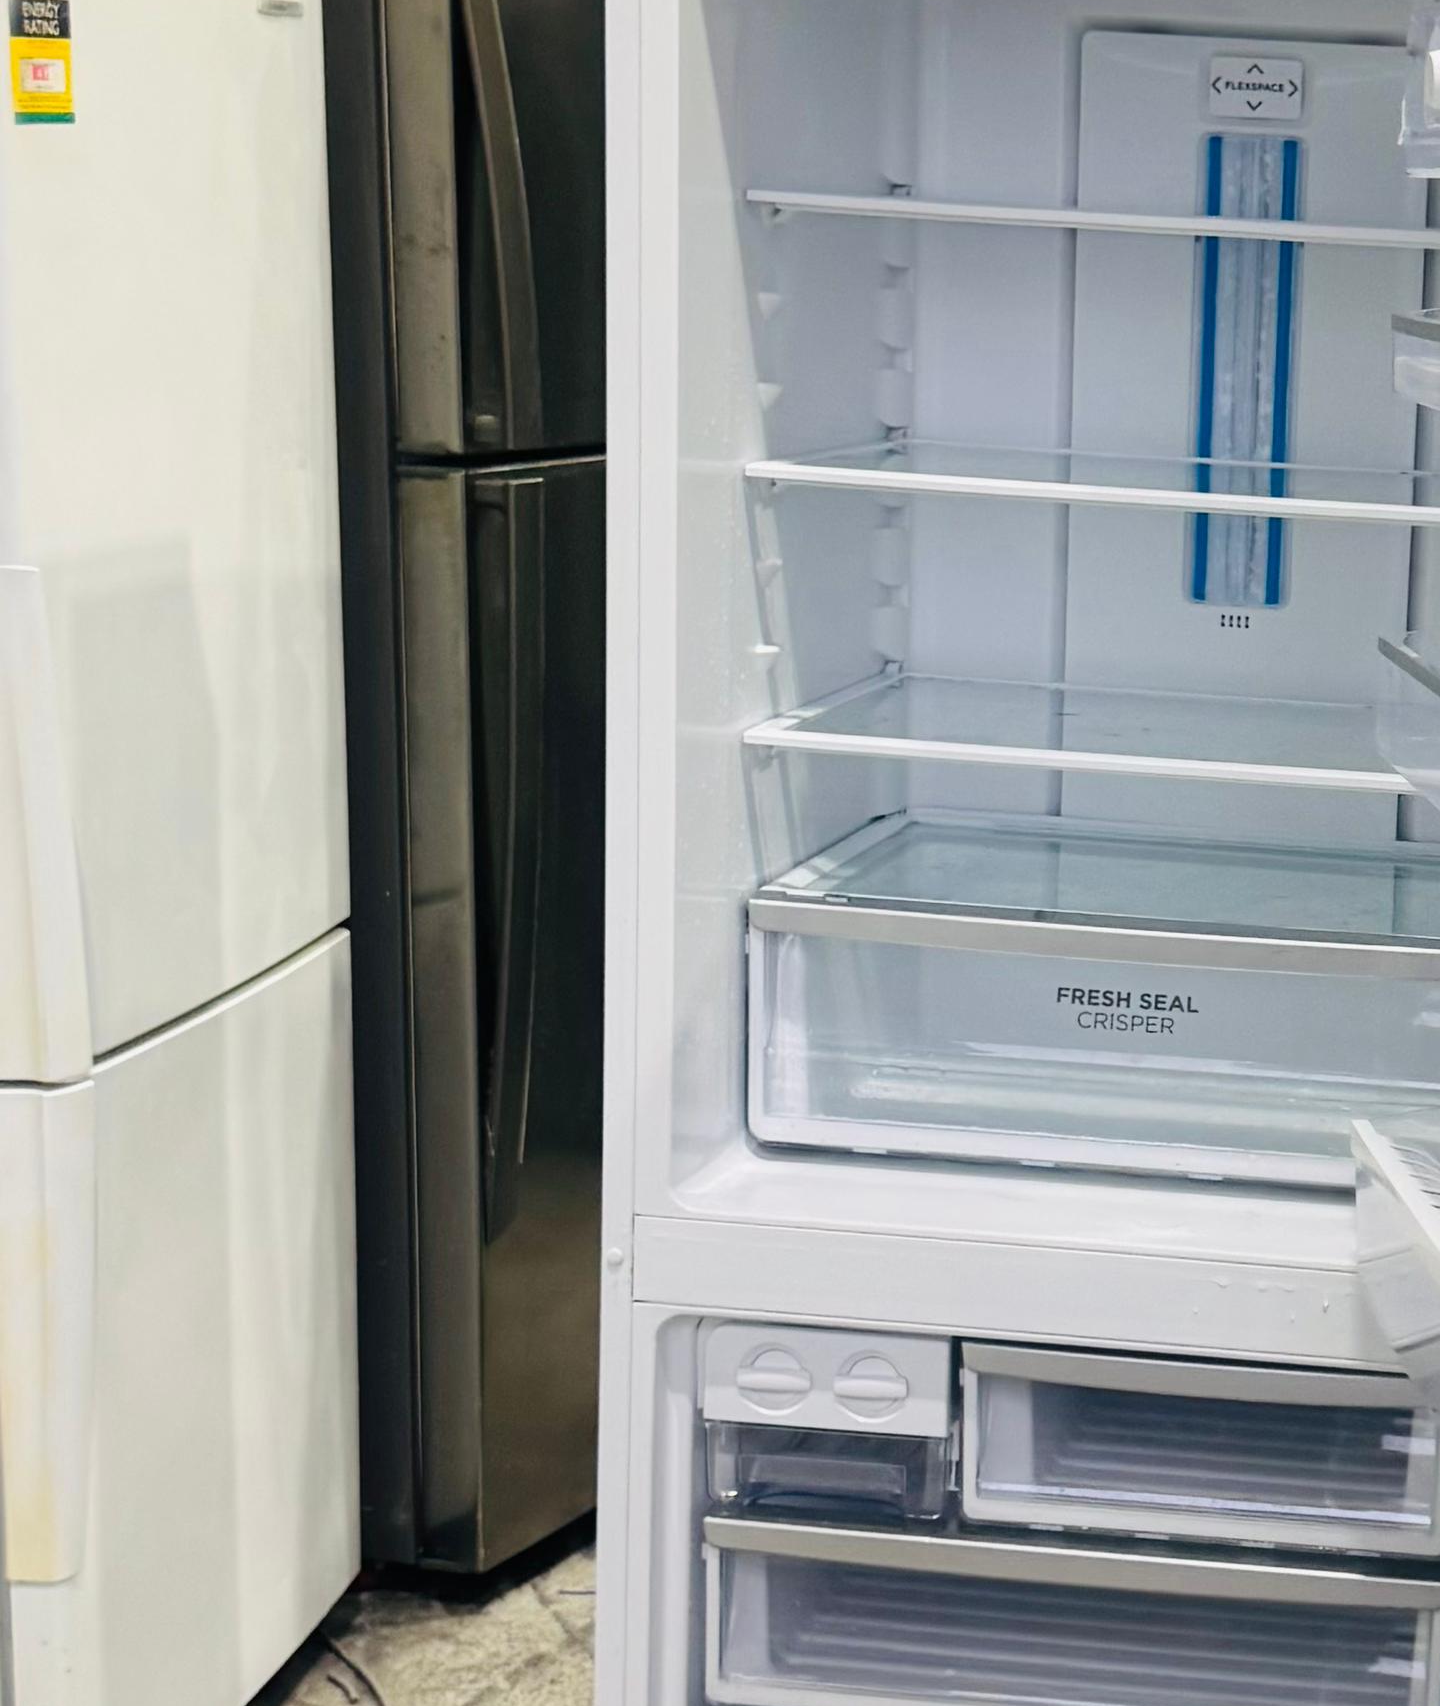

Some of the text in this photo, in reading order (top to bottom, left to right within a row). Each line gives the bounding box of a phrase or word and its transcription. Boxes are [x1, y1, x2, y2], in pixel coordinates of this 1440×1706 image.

[1225, 81, 1284, 92] FLEXSPACE
[1056, 987, 1199, 1013] FRESH SEAL
[1077, 1011, 1175, 1034] CRISPER
